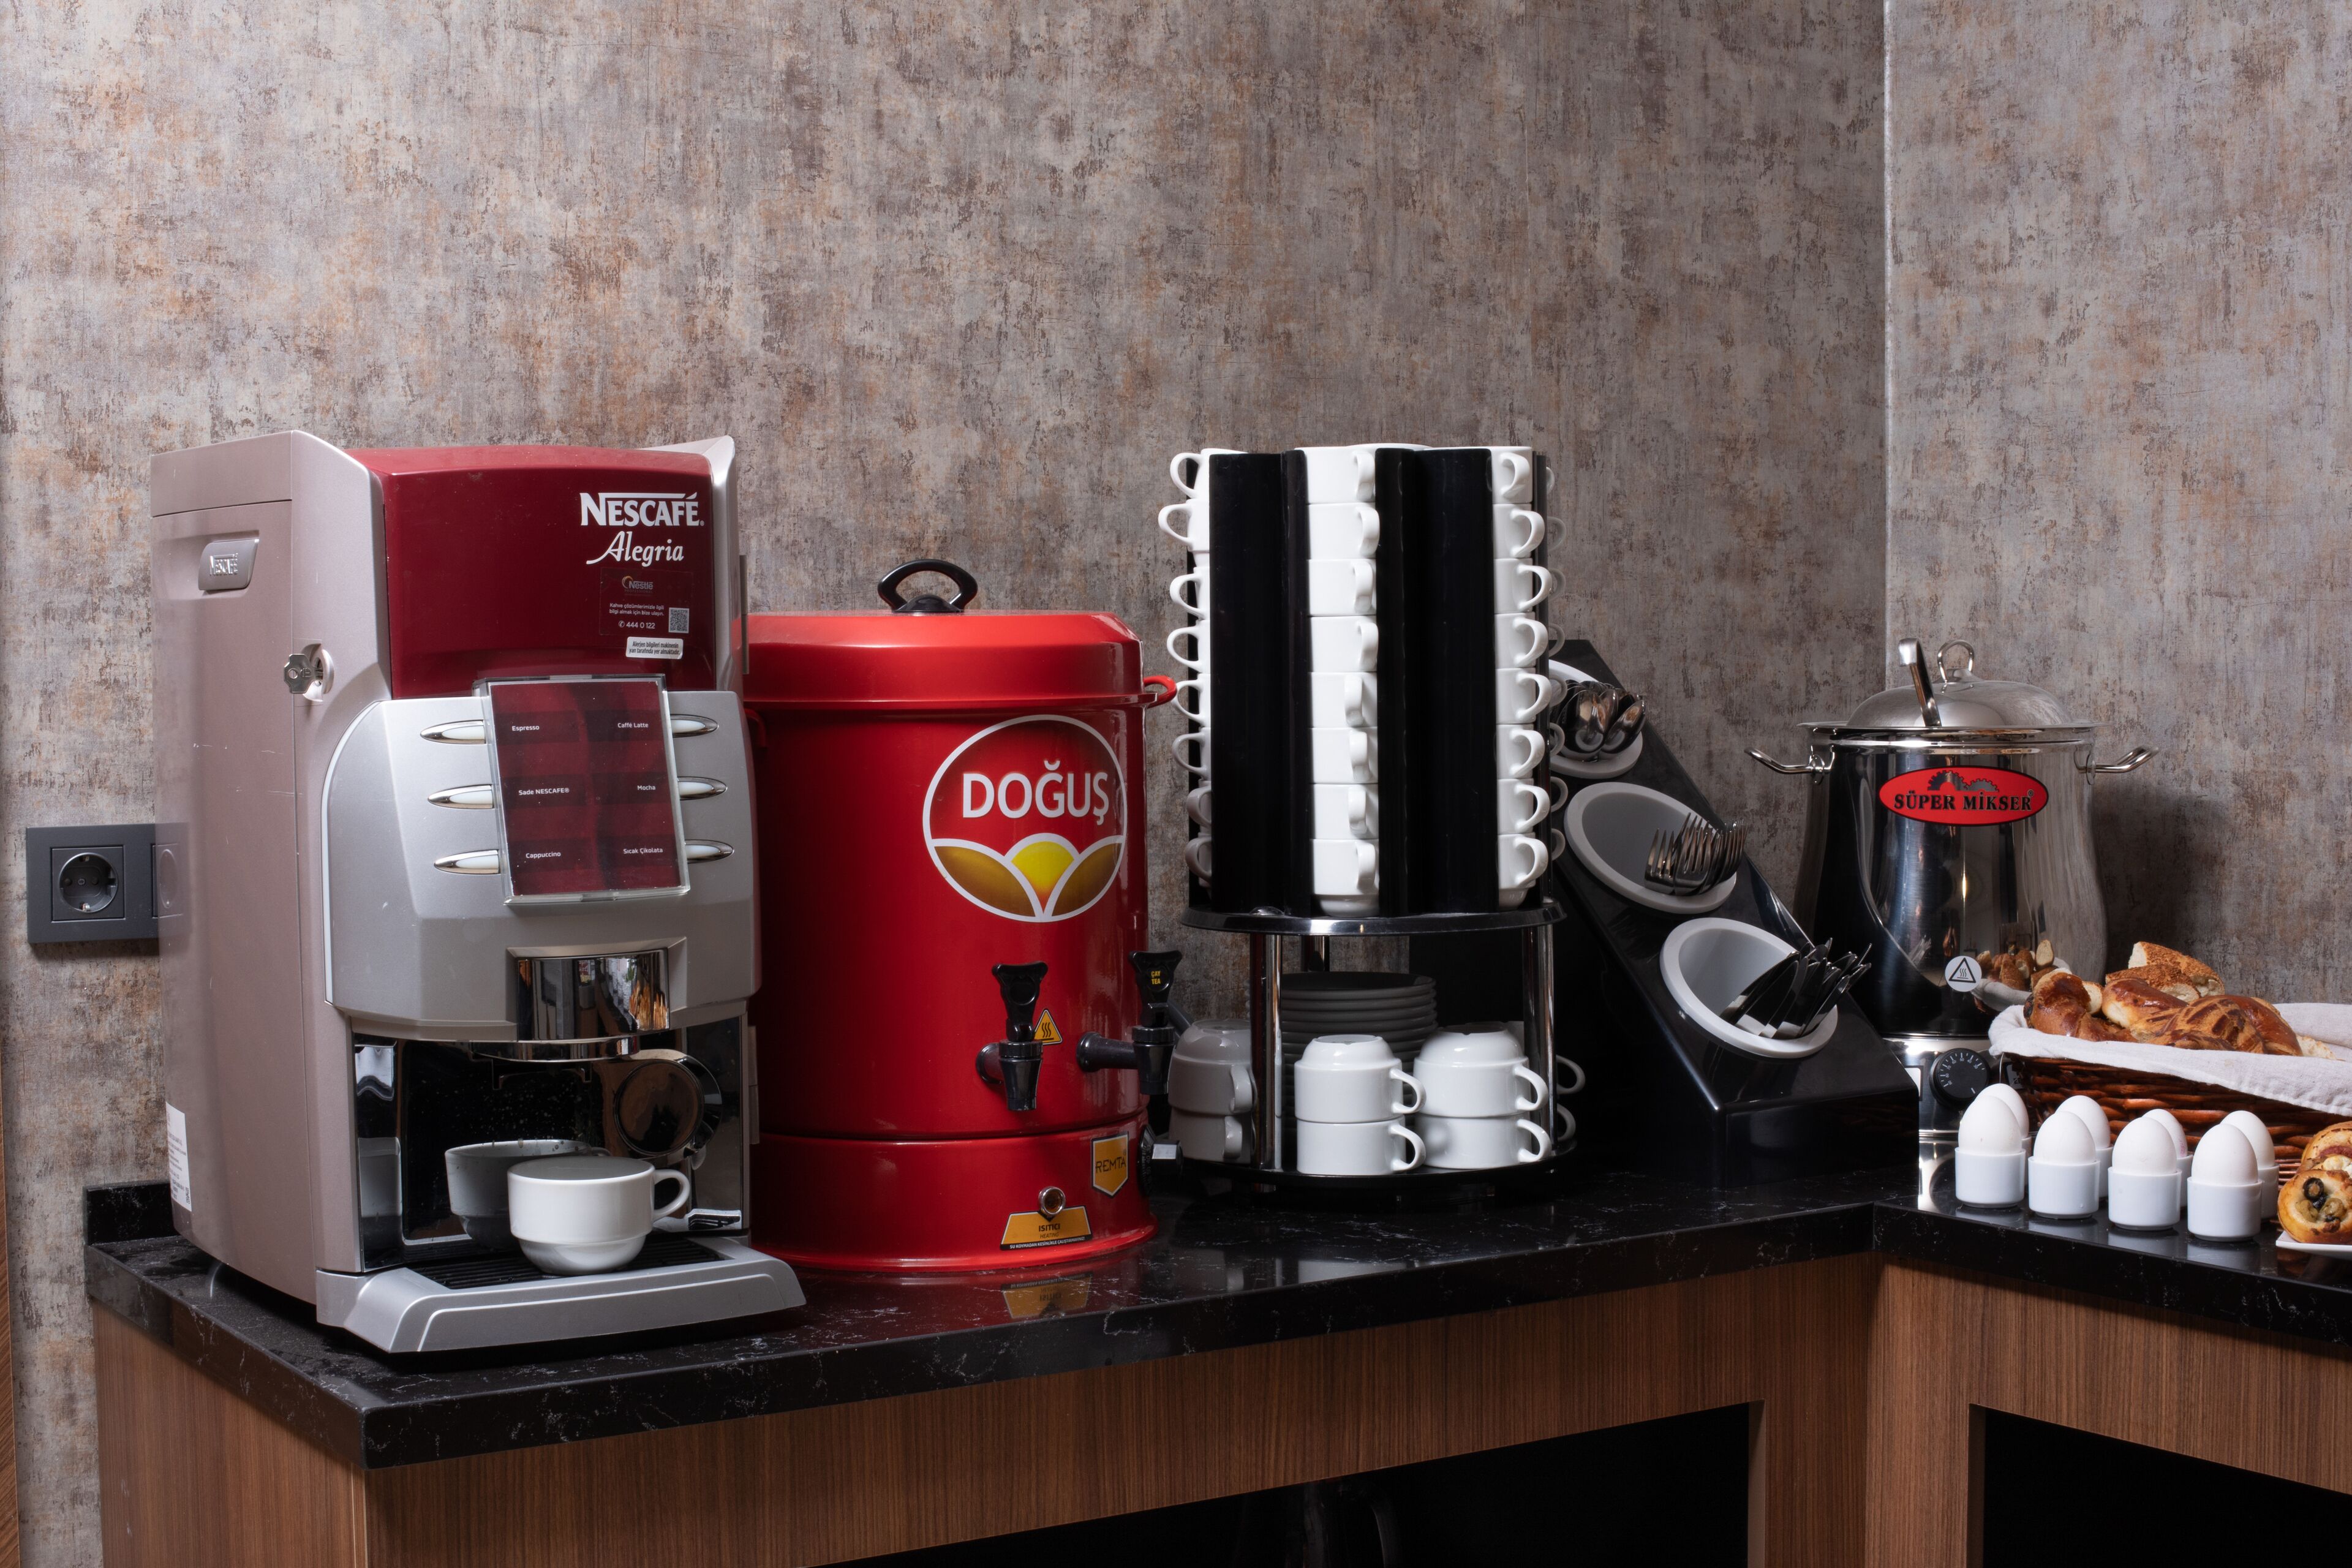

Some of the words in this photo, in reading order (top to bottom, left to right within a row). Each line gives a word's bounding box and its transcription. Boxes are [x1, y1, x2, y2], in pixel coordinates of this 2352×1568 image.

[579, 491, 700, 527] NESCAFÉ
[586, 530, 684, 567] Alegria
[963, 760, 1109, 826] DOĞUŞ
[1894, 790, 1956, 810] SÜPER
[1962, 791, 2032, 812] MİKSER
[526, 851, 561, 859] Cappuccino
[1151, 970, 1161, 979] ÇAY
[1095, 1156, 1127, 1174] REMTA
[1038, 1223, 1060, 1232] ISITICI
